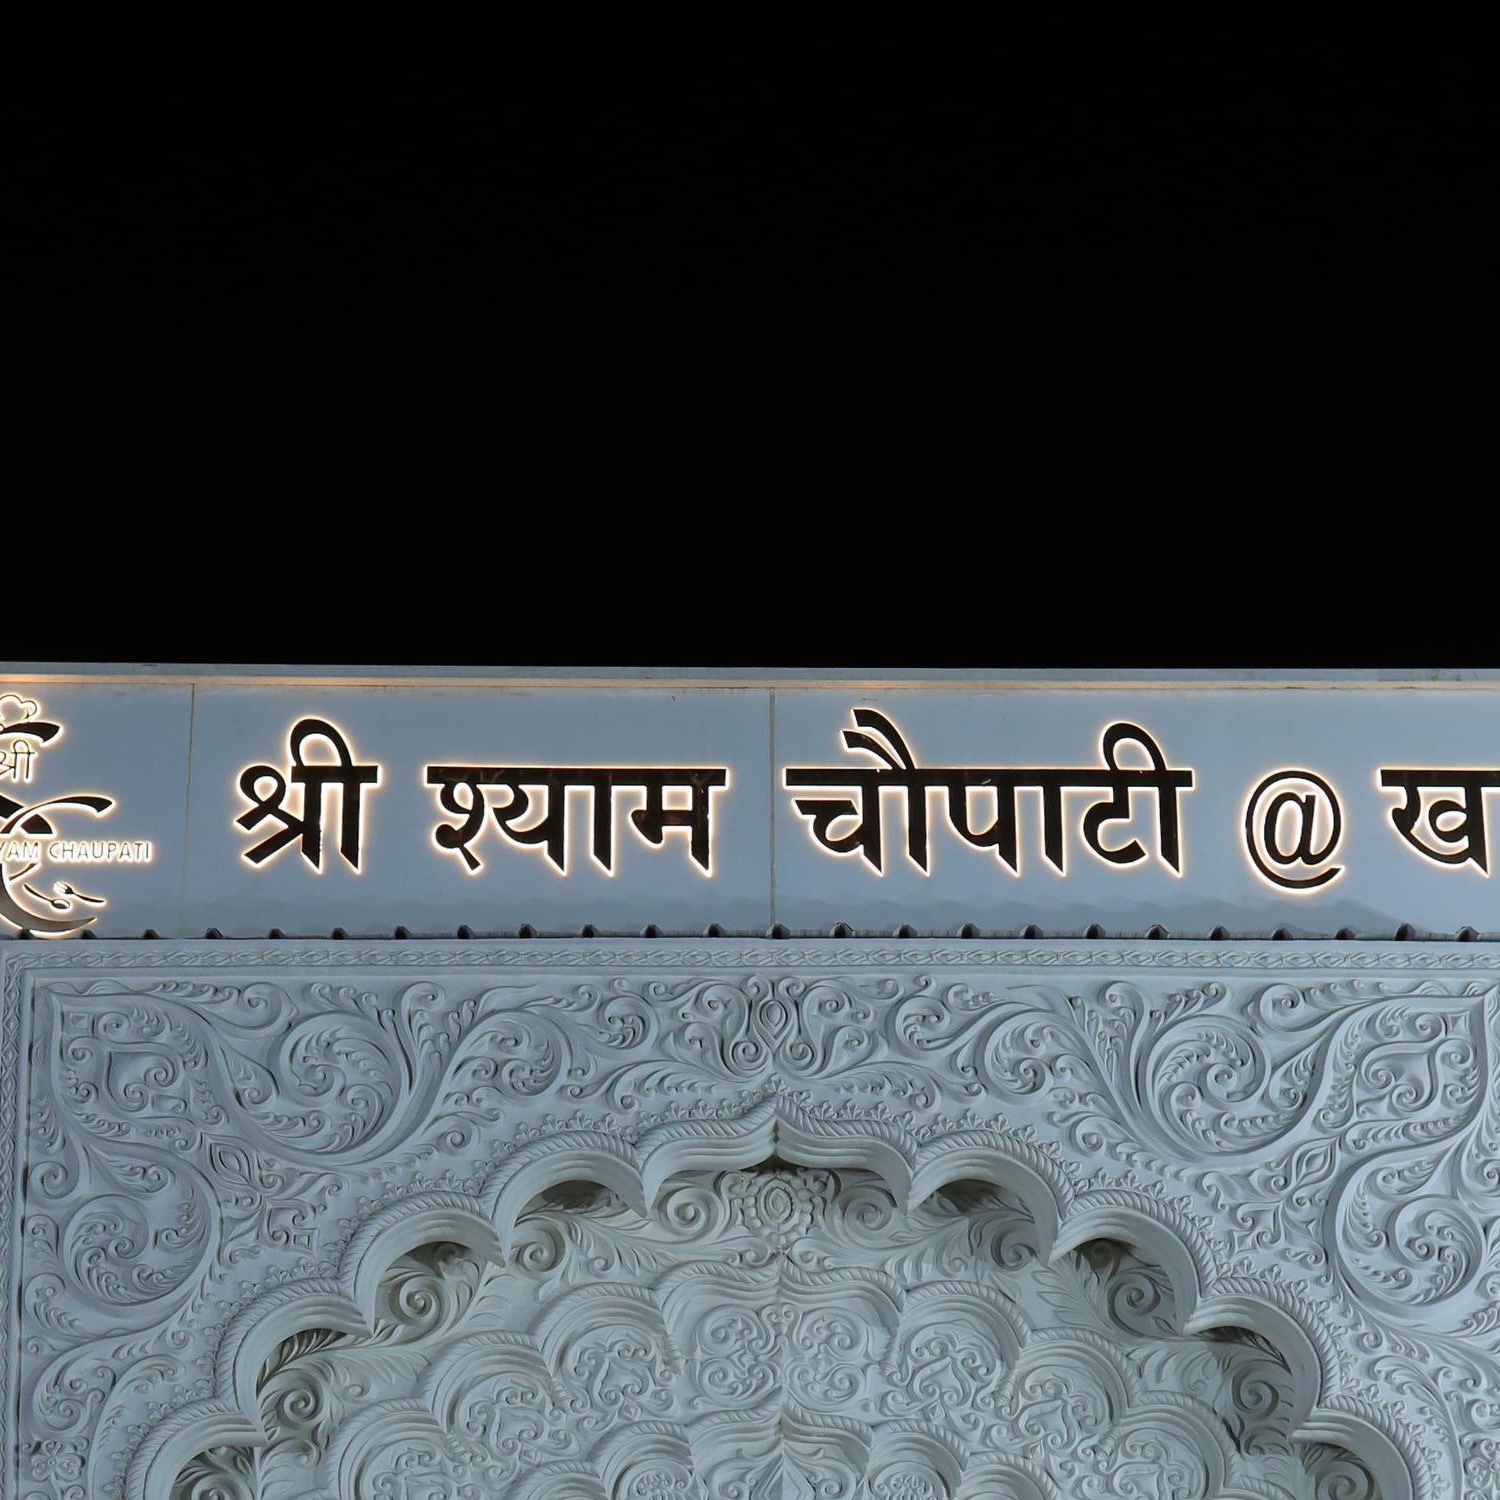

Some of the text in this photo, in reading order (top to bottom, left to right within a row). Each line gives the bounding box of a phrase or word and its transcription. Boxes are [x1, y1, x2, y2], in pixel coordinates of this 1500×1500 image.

[235, 718, 378, 870] श्री
[426, 766, 727, 873] श्याम
[784, 708, 1193, 874] चौपाटी
[1245, 770, 1346, 891] @
[48, 840, 152, 862] CHAUPATI
